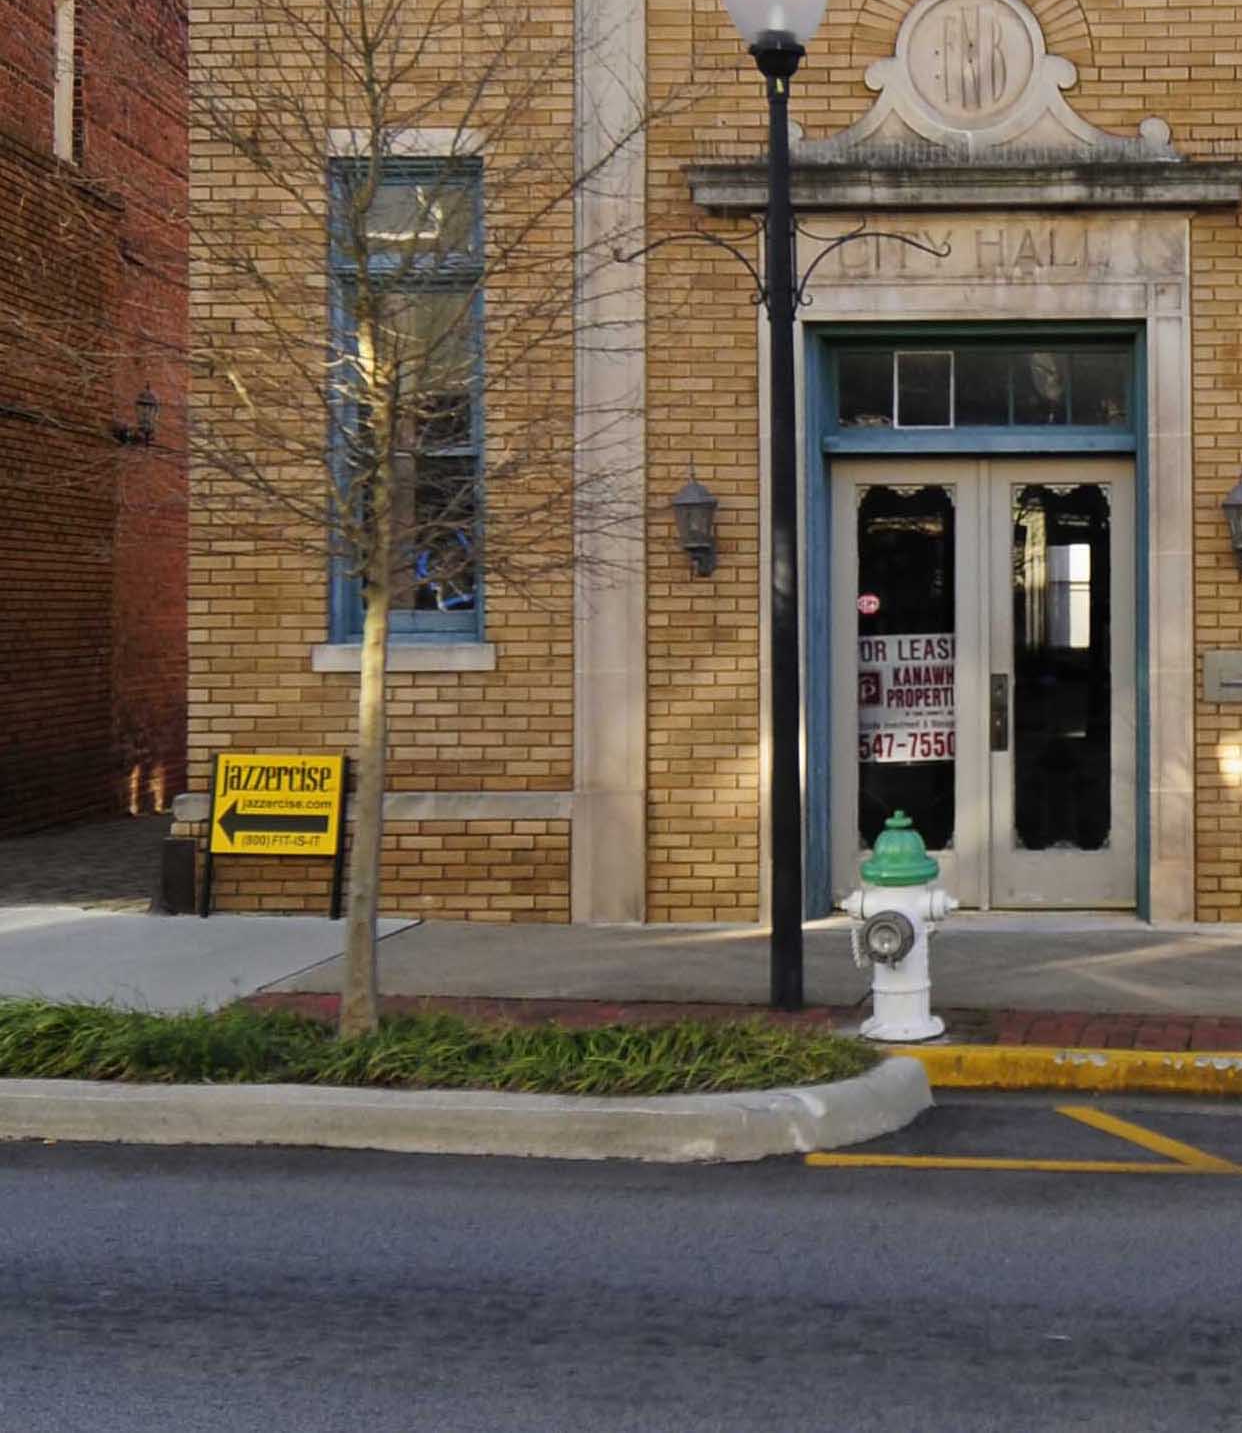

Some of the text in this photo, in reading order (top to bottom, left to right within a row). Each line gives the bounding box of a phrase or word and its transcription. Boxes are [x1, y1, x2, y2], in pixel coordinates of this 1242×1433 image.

[942, 5, 1008, 110] FNB
[837, 228, 1111, 272] CITY HALL
[858, 638, 887, 663] OR
[219, 760, 332, 798] jazzercise
[242, 798, 332, 811] jazzercise.com
